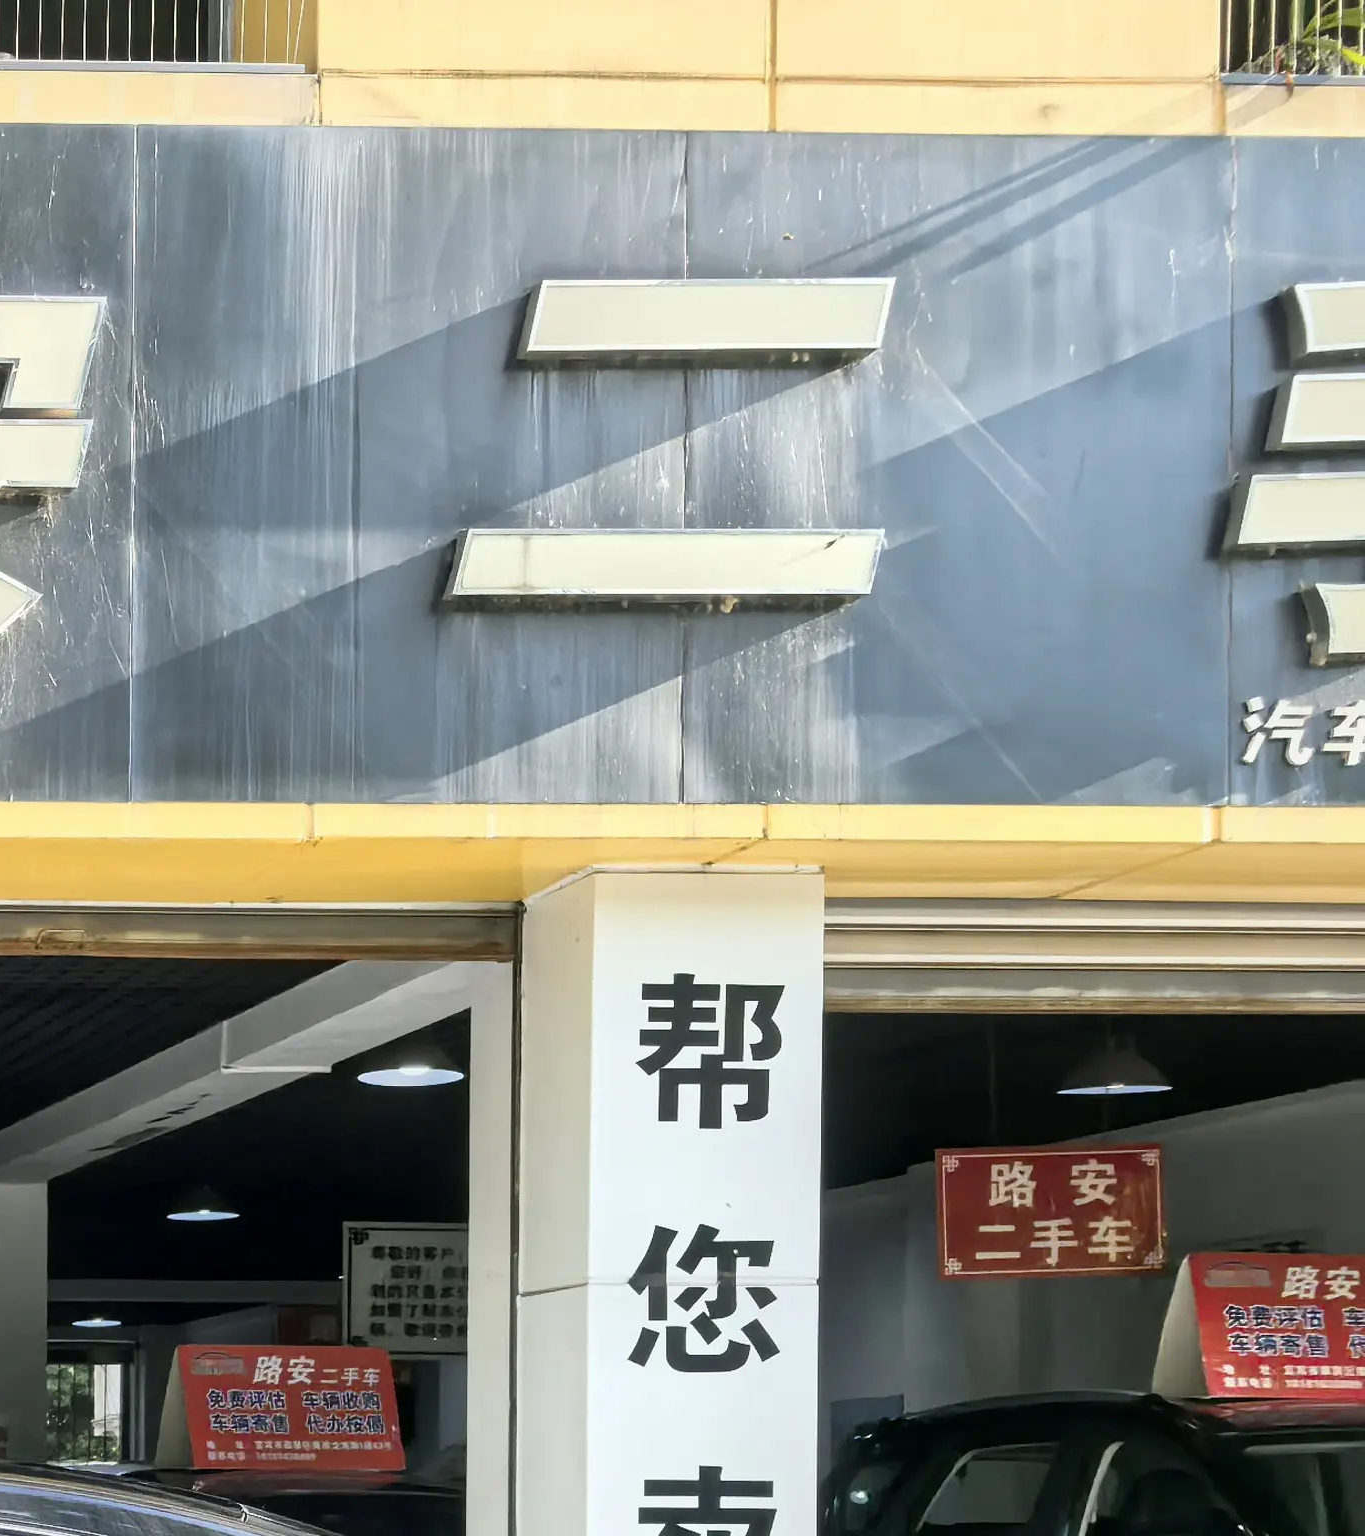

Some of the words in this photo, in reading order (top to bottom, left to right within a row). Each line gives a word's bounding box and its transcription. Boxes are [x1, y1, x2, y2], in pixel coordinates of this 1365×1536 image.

[988, 1159, 1117, 1208] 路安
[975, 1217, 1135, 1266] 二手车
[1281, 1266, 1361, 1300] 路安
[1223, 1304, 1325, 1331] 免费评估
[1226, 1332, 1330, 1360] 车辆寄售
[253, 1355, 380, 1386] 路安二手车
[207, 1389, 286, 1411] 免费评估
[301, 1390, 382, 1411] 车辆收购
